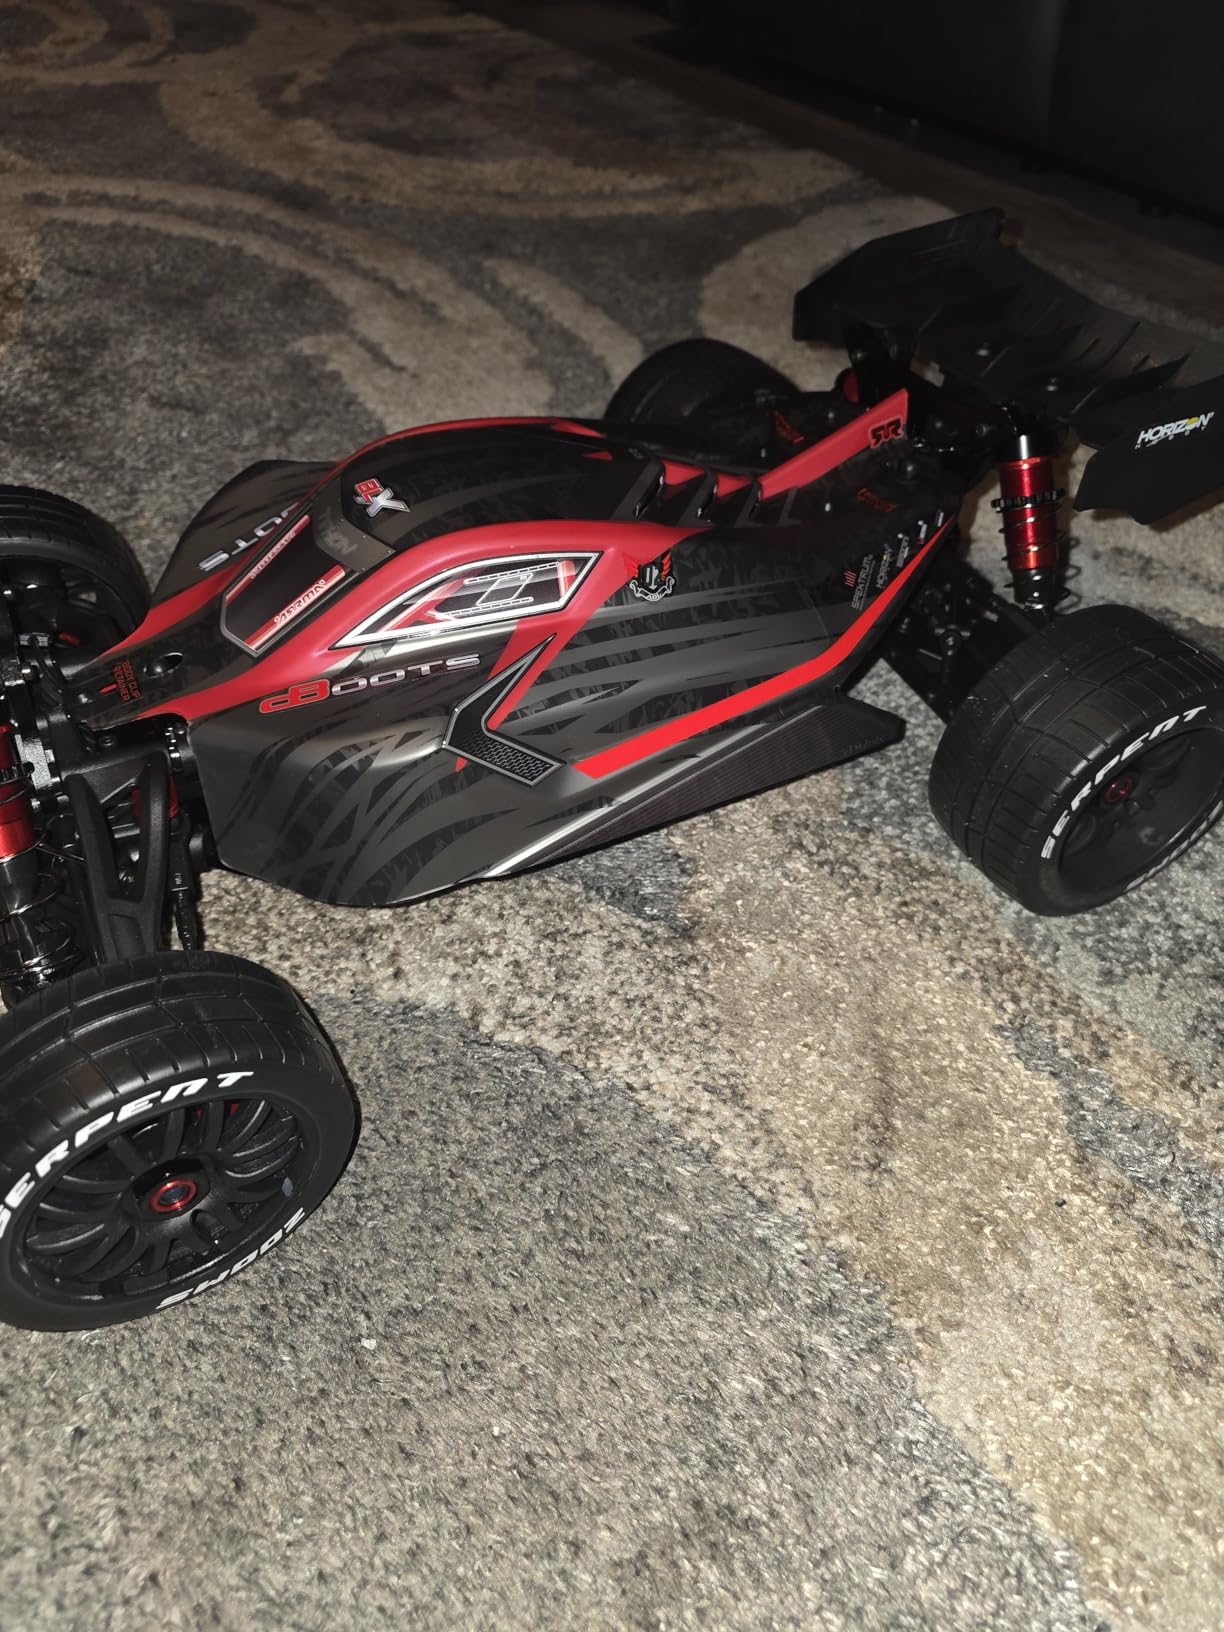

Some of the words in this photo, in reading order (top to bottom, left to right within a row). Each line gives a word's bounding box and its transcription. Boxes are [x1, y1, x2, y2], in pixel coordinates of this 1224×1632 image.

[1136, 413, 1213, 445] HORIZON
[353, 478, 411, 517] BLX
[851, 556, 872, 610] SPEKTRUM
[113, 665, 129, 702] RETAINER
[122, 660, 135, 682] BODY
[1040, 705, 1207, 859] SERPENT
[156, 1207, 305, 1310] ZOOMS
